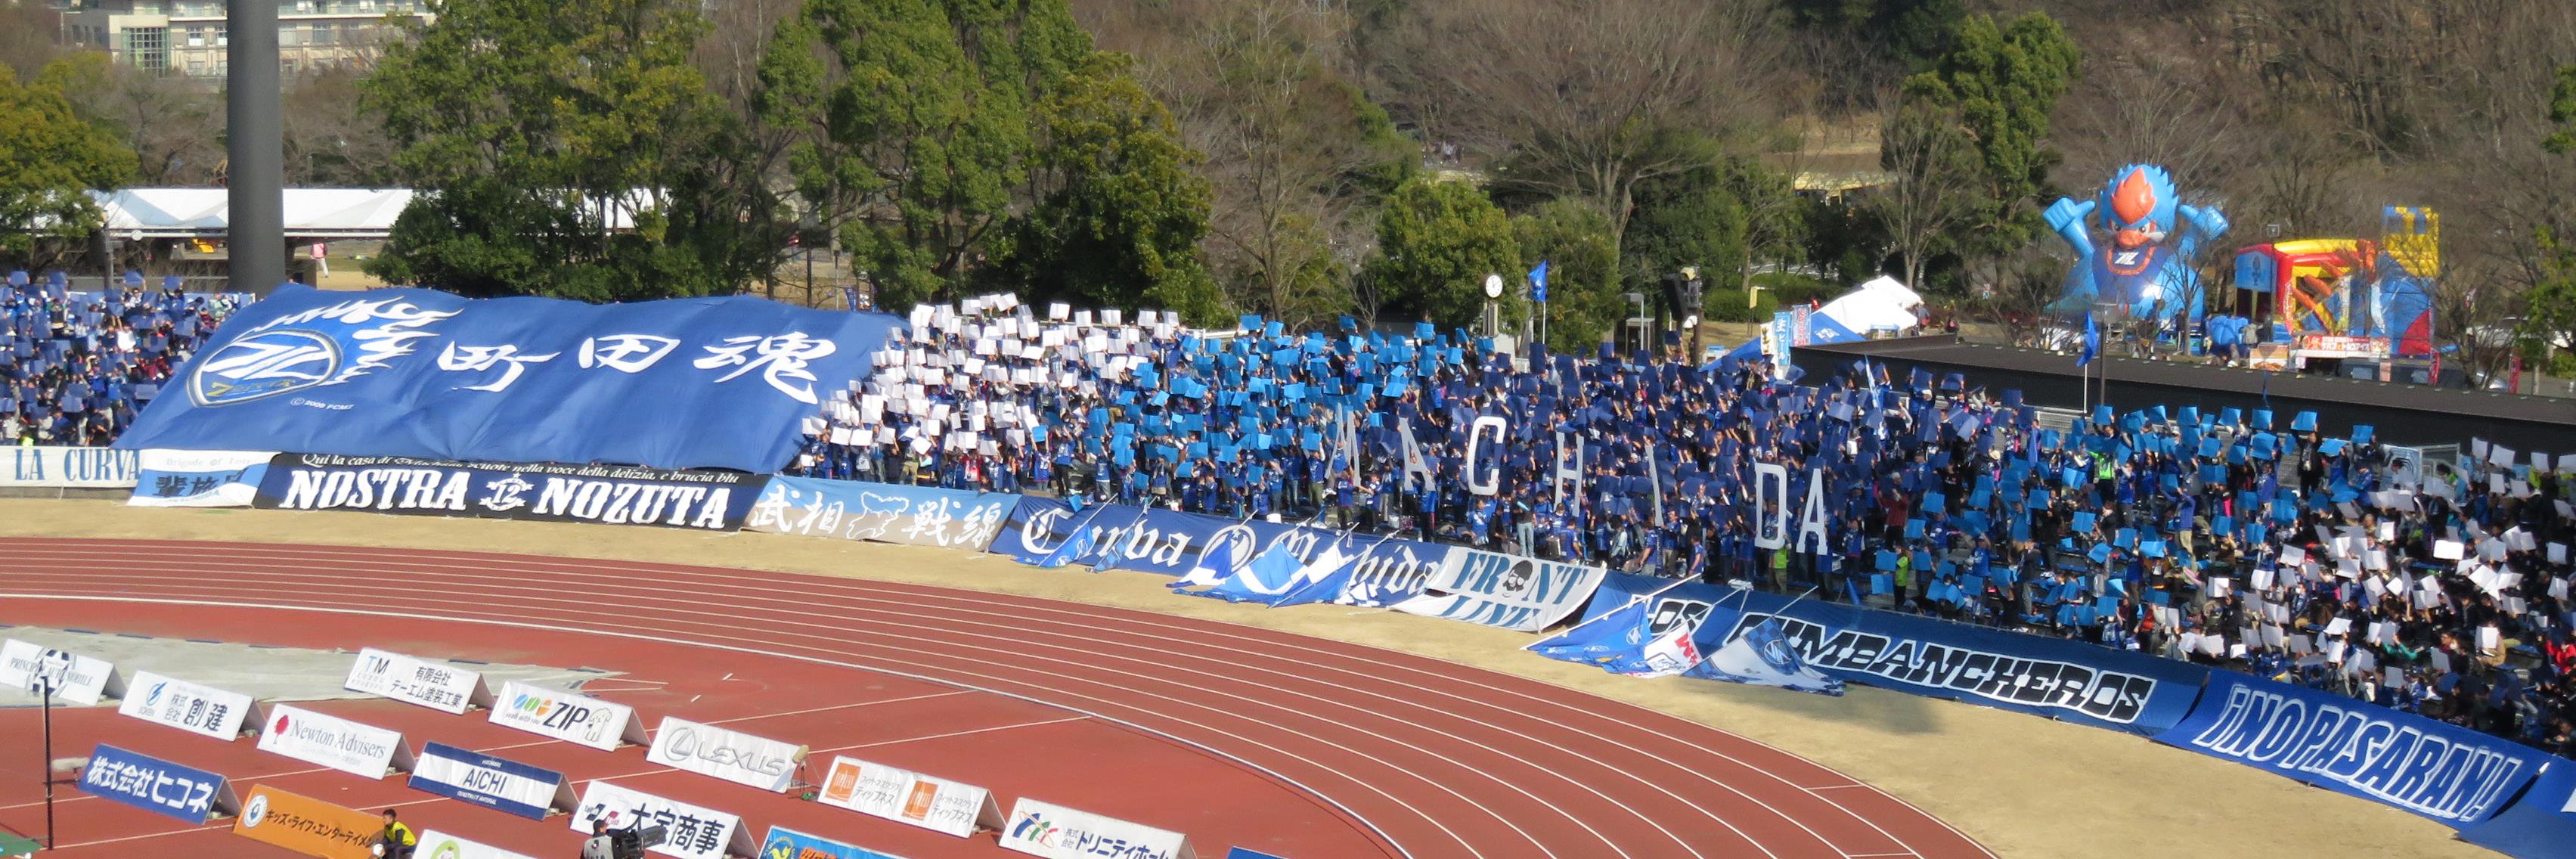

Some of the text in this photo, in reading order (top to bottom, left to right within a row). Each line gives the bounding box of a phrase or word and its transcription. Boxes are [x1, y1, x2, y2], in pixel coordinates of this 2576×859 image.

[437, 331, 836, 404] 町田魂
[15, 448, 142, 481] LA CURVA
[302, 454, 331, 468] Qui
[332, 454, 346, 465] la
[348, 457, 376, 466] casa
[468, 462, 510, 472] scuote
[512, 463, 544, 474] nella
[546, 466, 576, 476] voce
[577, 465, 608, 478] della
[660, 473, 668, 481] e
[671, 470, 716, 483] brucia
[718, 473, 739, 484] blu
[278, 468, 731, 529] NOSTRA 12 NOZUTA
[1255, 529, 1443, 595] Mhida
[1628, 594, 1715, 636] OS
[365, 656, 390, 674] TM
[415, 666, 452, 686] 有限会社
[390, 680, 463, 708] テーエム塗装工業
[183, 697, 228, 732] 創建
[542, 702, 590, 730] ZIP
[290, 719, 335, 746] Newton
[335, 732, 386, 758] Advisers
[696, 740, 786, 777] LEXUS
[87, 755, 213, 813] 株式会社ヒコネ
[463, 768, 507, 794] AICHI
[854, 786, 895, 806] ティップネス
[932, 805, 974, 824] ティップネス
